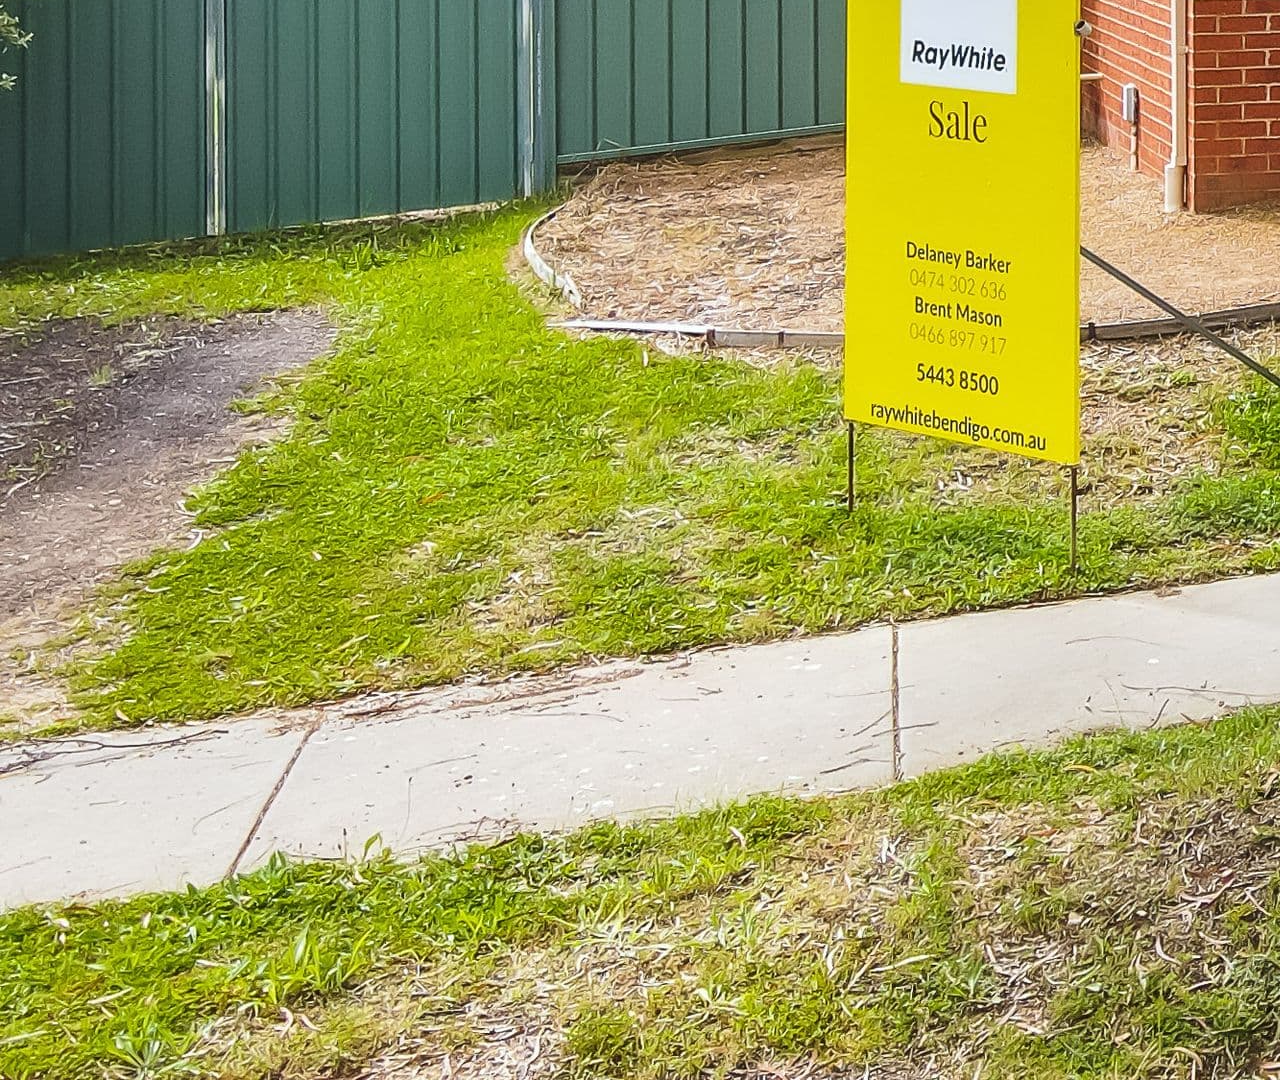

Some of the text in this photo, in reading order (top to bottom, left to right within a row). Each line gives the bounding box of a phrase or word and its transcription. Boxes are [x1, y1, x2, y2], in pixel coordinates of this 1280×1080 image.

[928, 100, 988, 143] Sale
[906, 241, 1012, 274] Delaney Barker
[909, 268, 1007, 301] 0474 302 636
[914, 296, 1003, 327] Brent Mason
[909, 322, 1007, 356] 0466 897 917
[916, 363, 999, 396] 5443 8500
[870, 403, 1047, 451] raywhitebendigo.com.au
